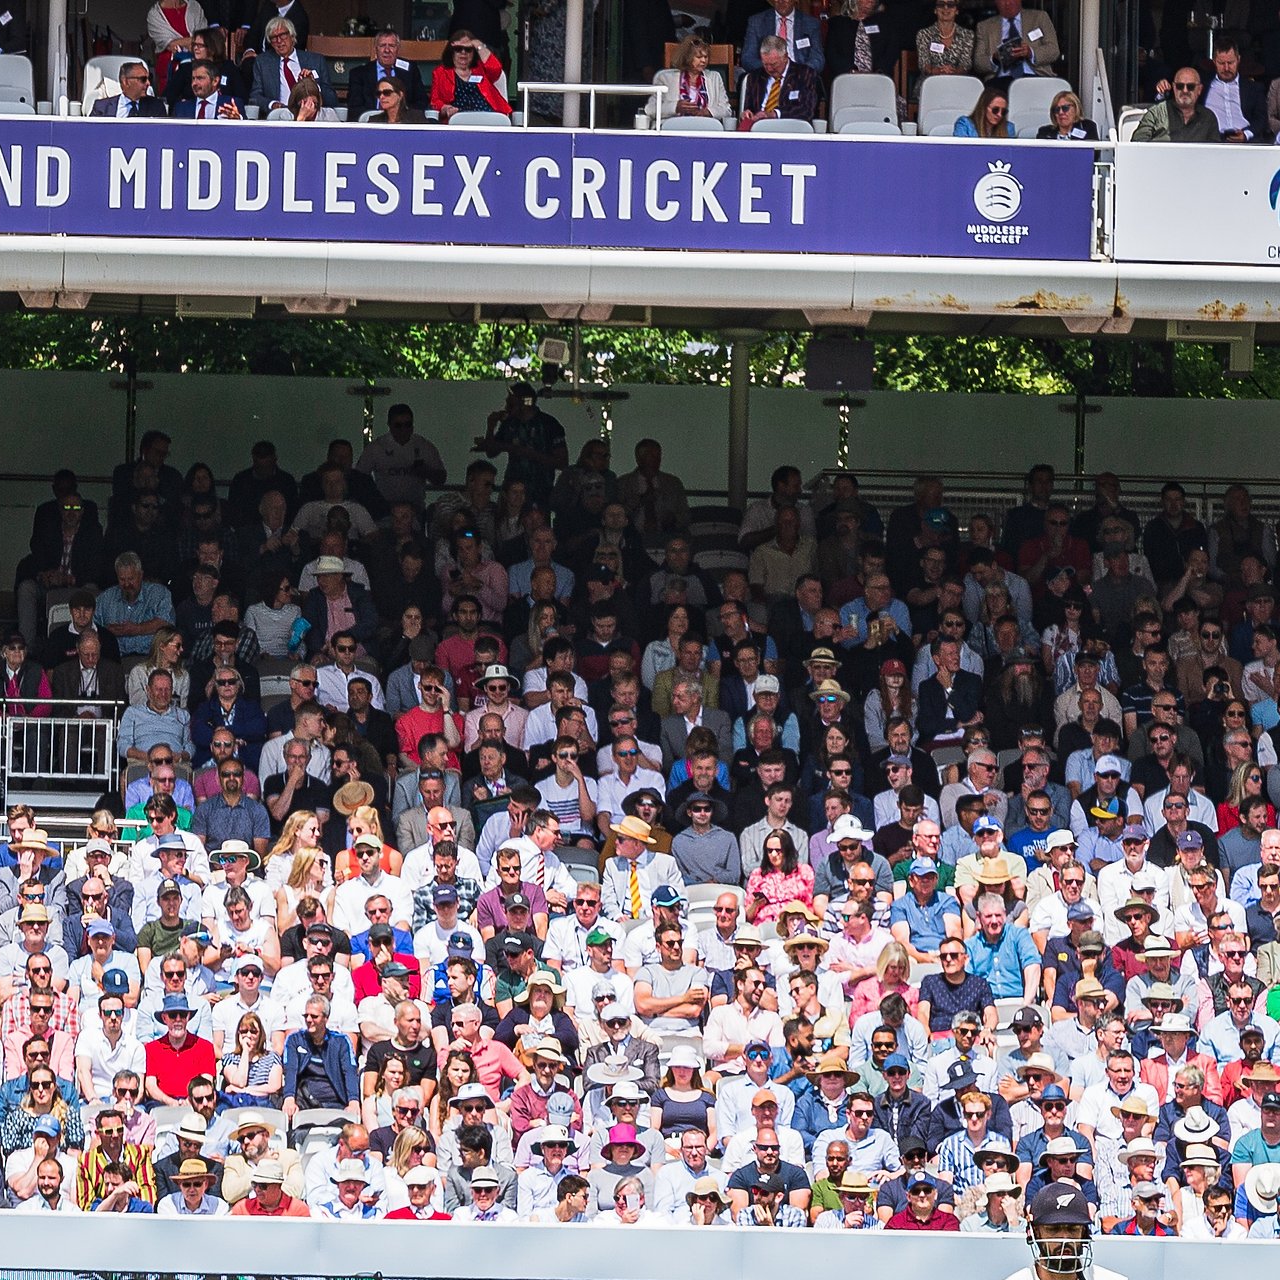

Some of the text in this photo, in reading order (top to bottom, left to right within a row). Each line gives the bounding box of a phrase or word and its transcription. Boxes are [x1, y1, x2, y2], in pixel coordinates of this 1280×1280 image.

[108, 147, 492, 218] MIDDLESEX
[523, 156, 817, 226] CRICKET
[966, 224, 1029, 236] MIDDLESEX
[974, 233, 1022, 244] CRICKET
